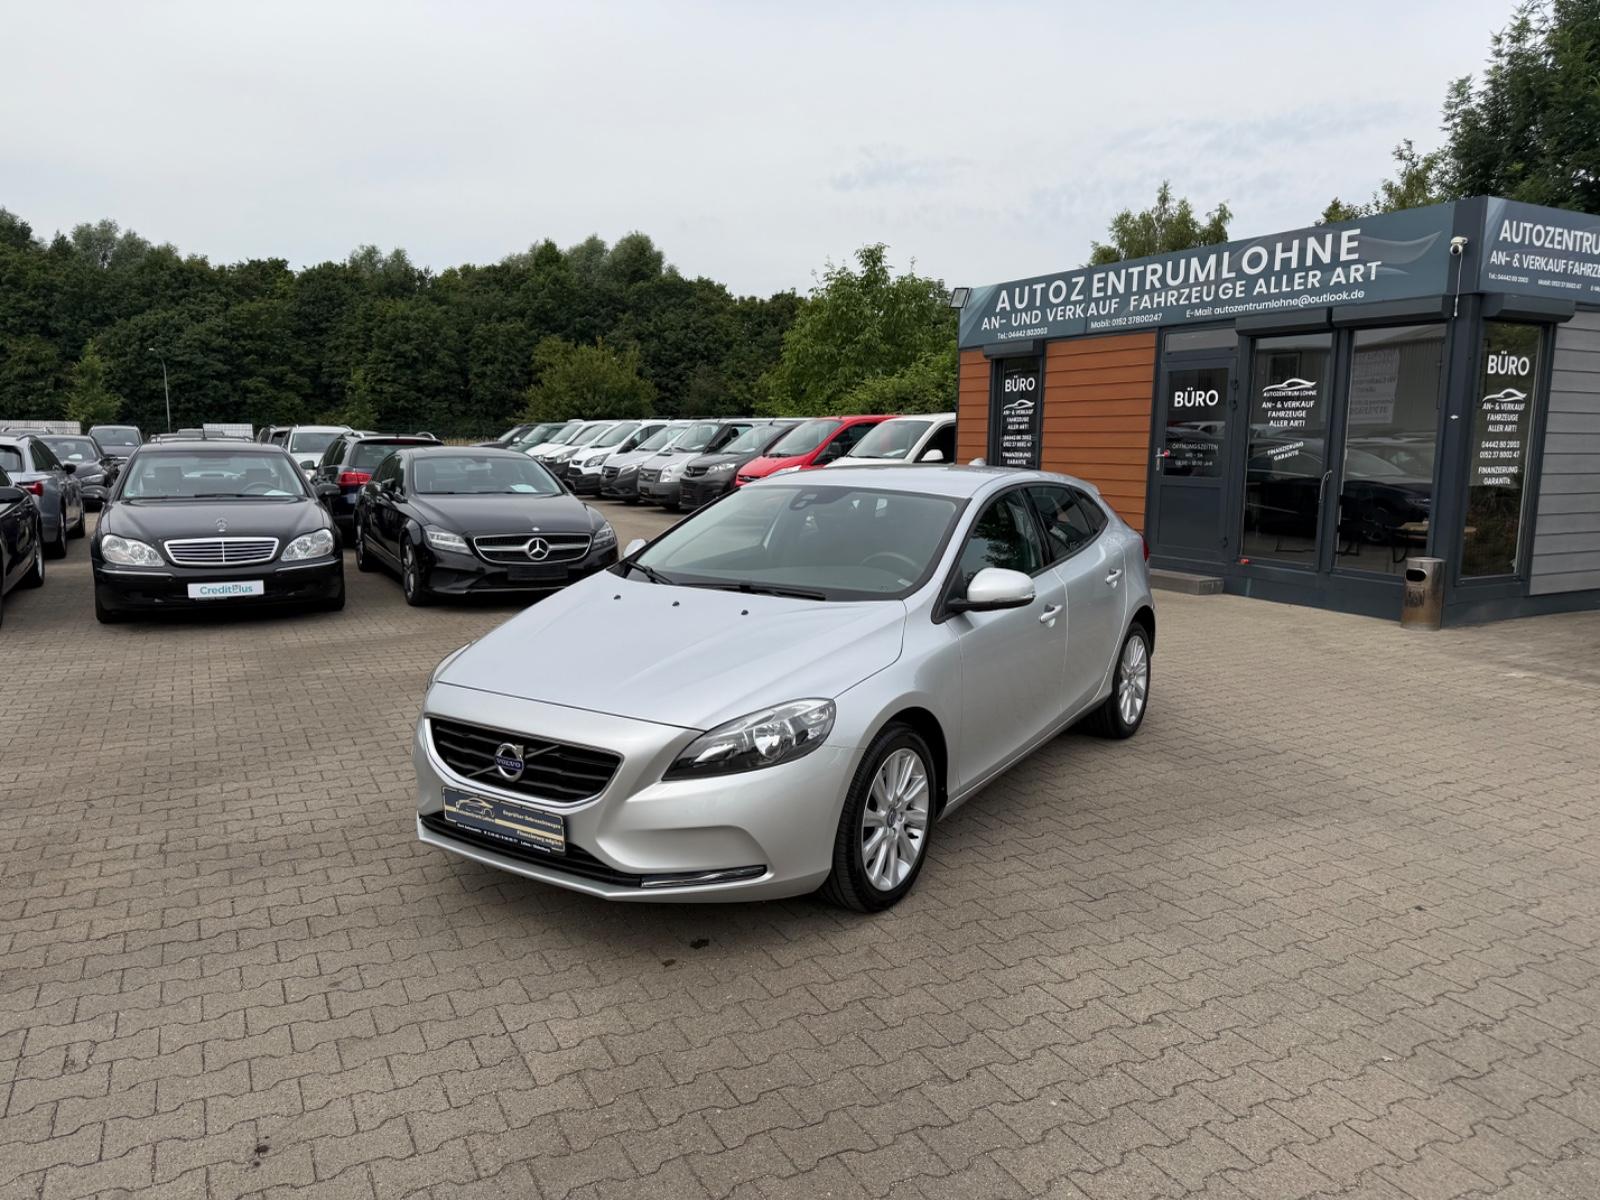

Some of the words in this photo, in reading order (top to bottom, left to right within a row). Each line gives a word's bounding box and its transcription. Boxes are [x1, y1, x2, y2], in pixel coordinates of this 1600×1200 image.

[1490, 250, 1511, 266] AN-
[1512, 253, 1520, 268] &
[1522, 254, 1567, 273] VERKAUF
[981, 315, 1007, 331] AN-
[1011, 310, 1041, 326] UND
[1046, 298, 1119, 322] VERKAUF
[1129, 280, 1246, 311] FAHRZEUGE
[1253, 270, 1321, 296] ALLER
[1329, 261, 1382, 286] ART
[1214, 289, 1365, 315] autozentrumlohne@outlook.de
[1487, 350, 1530, 376] BÜRO
[1005, 375, 1035, 392] BÜRO
[1174, 386, 1219, 407] BÜRO
[1262, 400, 1275, 408] AN-
[1283, 400, 1315, 408] VERKAUF
[1500, 402, 1526, 411] VERKAUF
[1267, 410, 1307, 418] FAHRZEUGE
[1487, 413, 1519, 422] FAHRZEUGE
[1488, 424, 1504, 432] ALLER
[1479, 465, 1518, 474] FINANZIERUNG
[200, 584, 253, 595] CreditPlus
[496, 757, 521, 768] VOLVO
